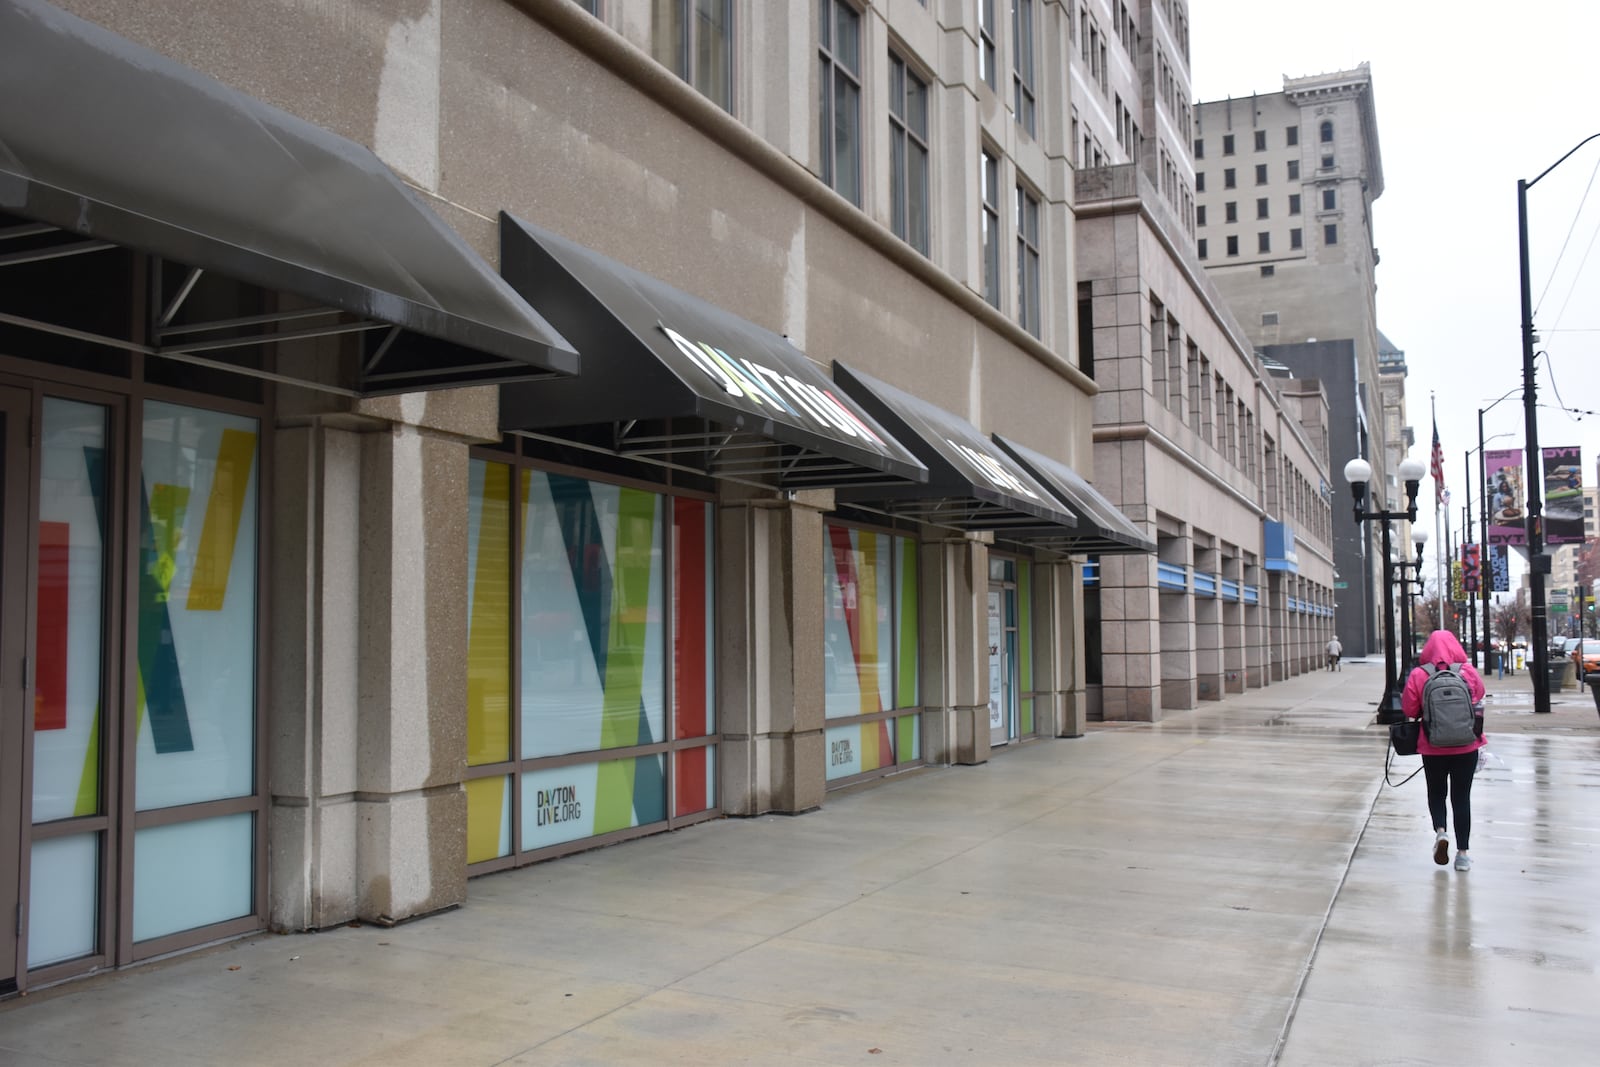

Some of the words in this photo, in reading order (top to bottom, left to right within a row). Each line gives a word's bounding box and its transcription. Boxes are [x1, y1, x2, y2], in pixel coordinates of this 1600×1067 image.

[661, 323, 887, 447] DAYTON
[1543, 447, 1579, 458] DYT
[1489, 534, 1524, 544] DYT
[1464, 544, 1478, 591] DYT
[1493, 575, 1501, 591] DO
[537, 785, 576, 808] DAYTON
[537, 802, 581, 827] LIVE.ORG
